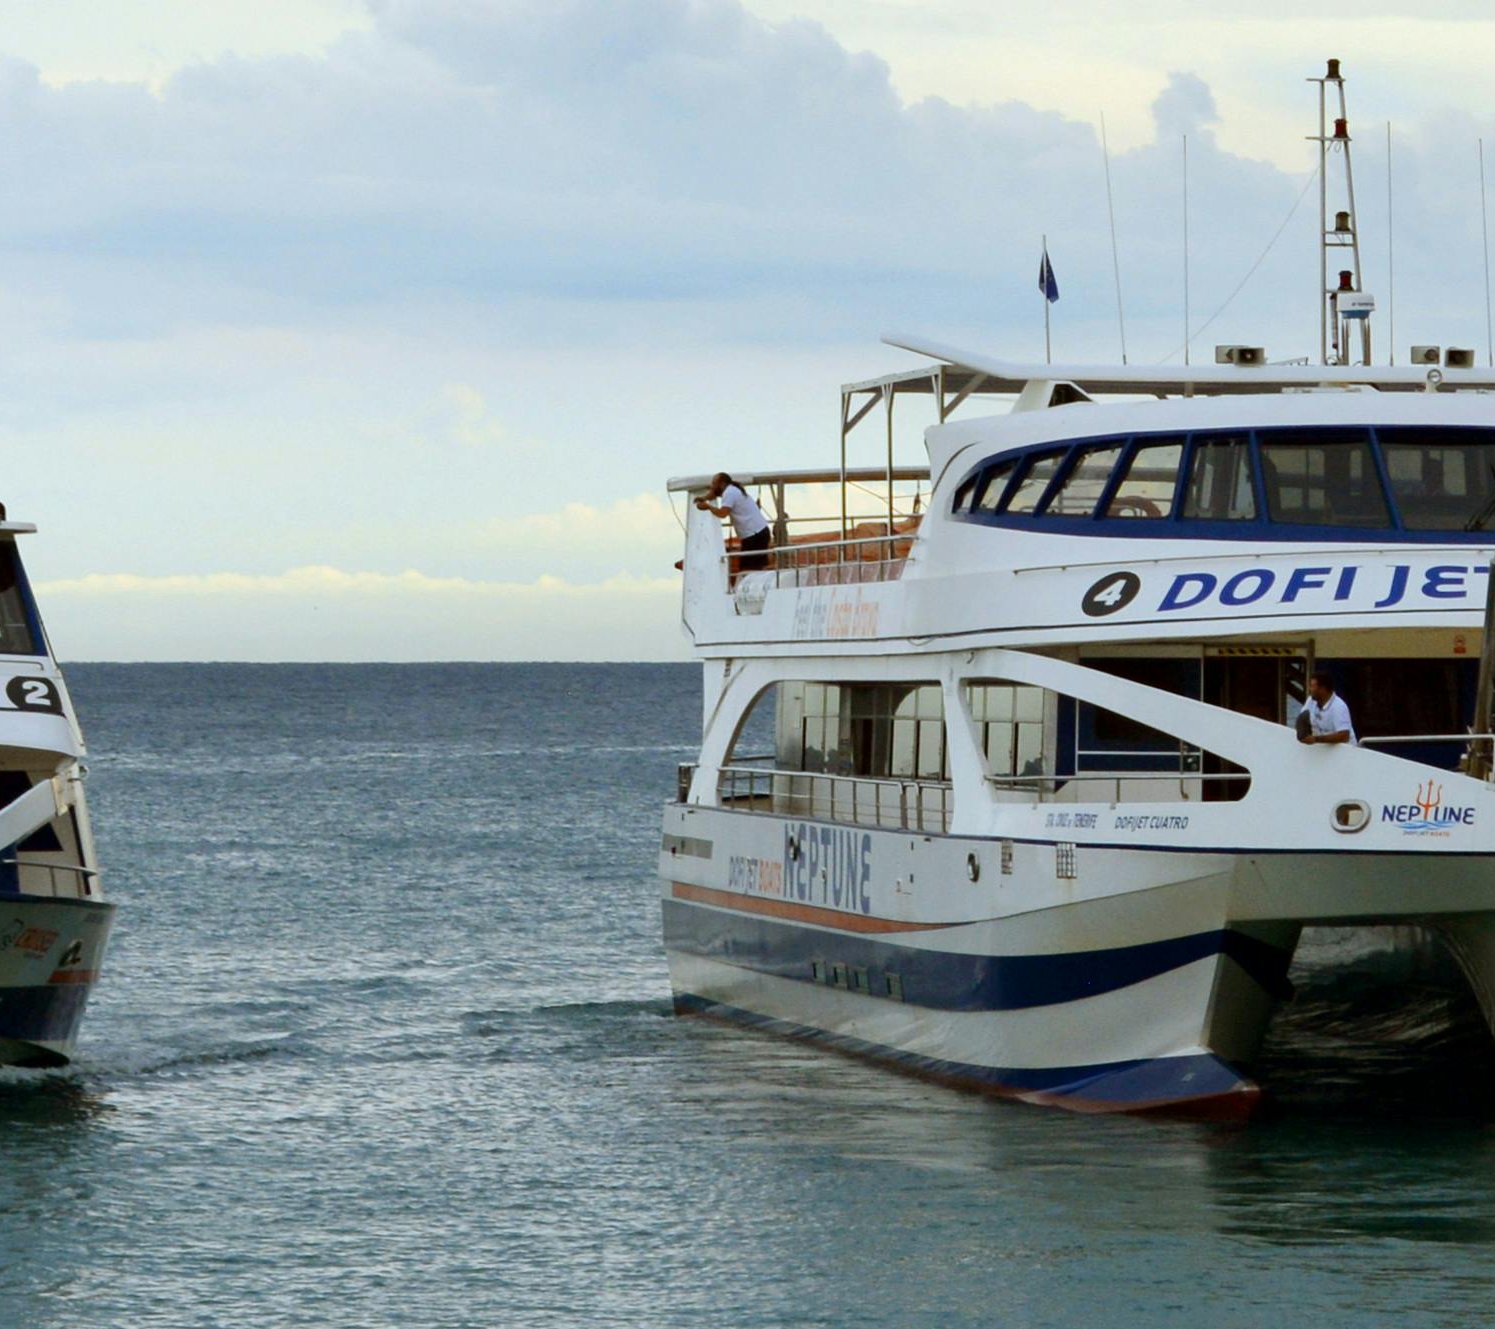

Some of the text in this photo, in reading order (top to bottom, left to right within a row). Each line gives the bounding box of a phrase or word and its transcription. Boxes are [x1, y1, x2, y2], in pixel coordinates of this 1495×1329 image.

[1094, 580, 1124, 607] 4
[1157, 565, 1362, 612] DOFI
[21, 680, 51, 706] 2
[1149, 816, 1189, 830] CUATRO
[783, 822, 871, 914] NEPTUNE
